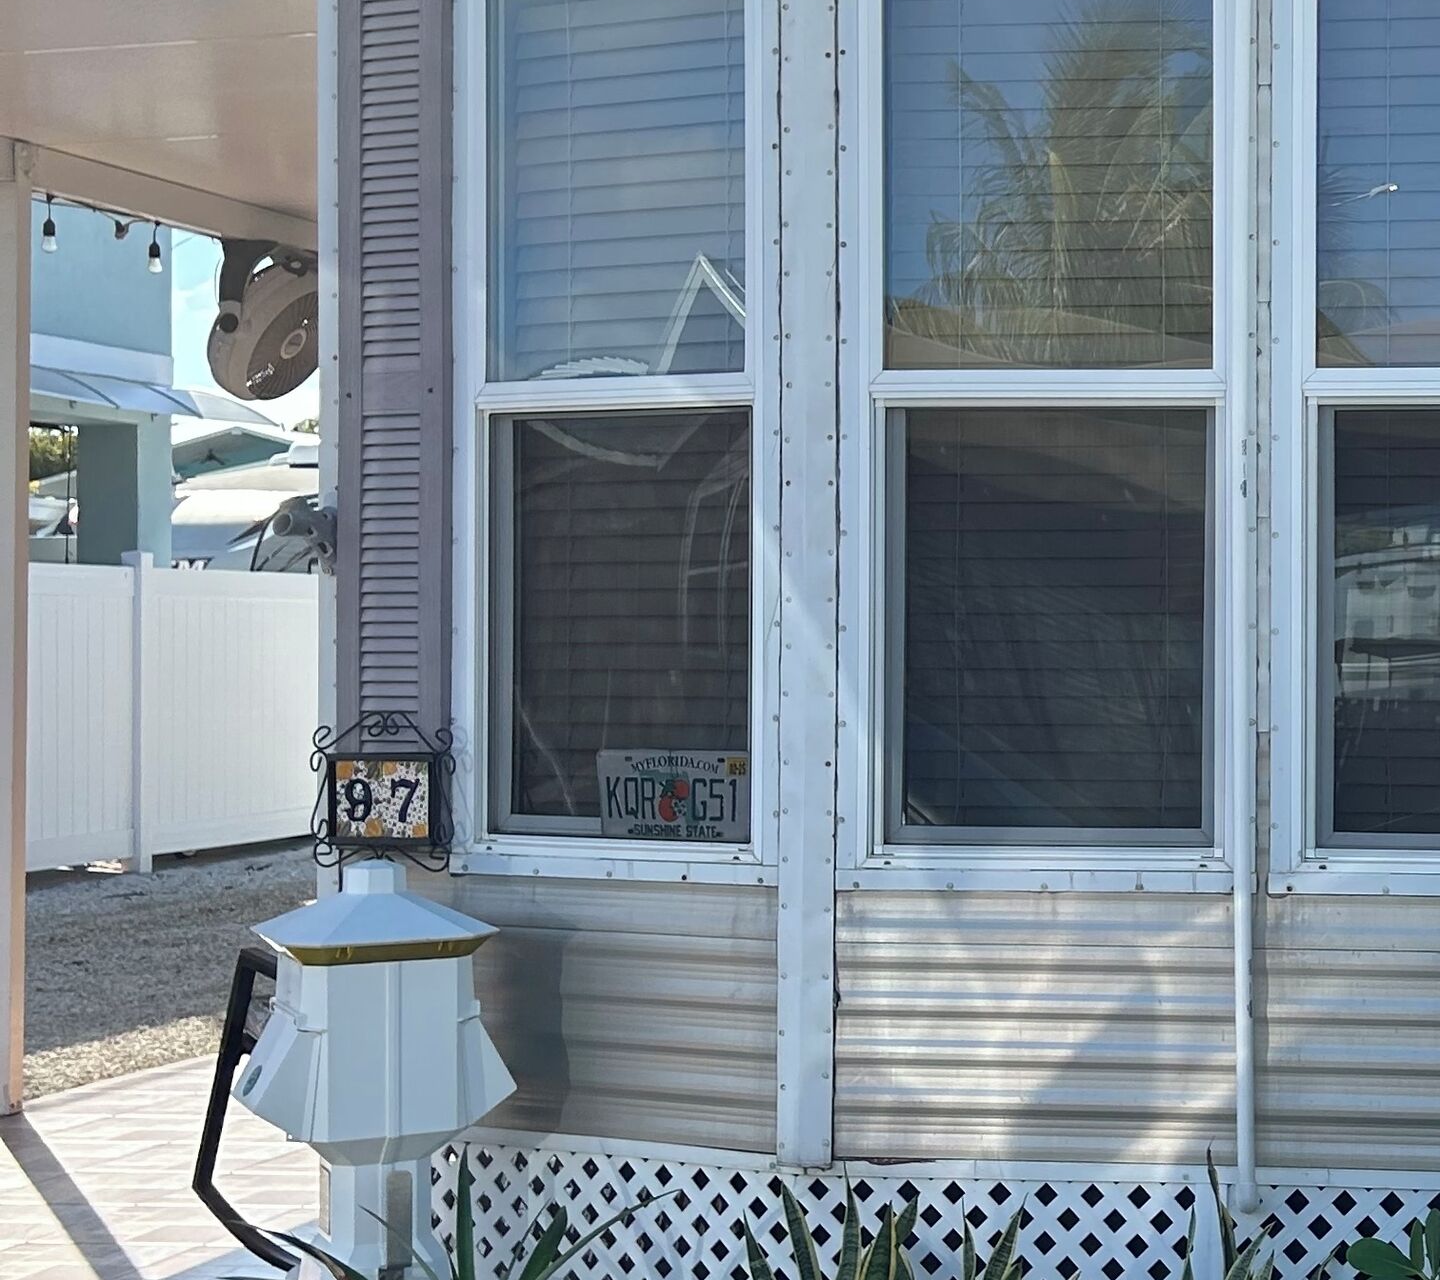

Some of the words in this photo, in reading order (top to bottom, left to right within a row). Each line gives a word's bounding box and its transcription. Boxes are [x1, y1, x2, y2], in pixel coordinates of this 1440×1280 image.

[630, 755, 720, 774] MYFLORIDA.COM
[605, 775, 657, 820] KQR
[691, 777, 738, 822] G51
[633, 823, 682, 837] SUNSHINE
[685, 825, 718, 838] STATE
